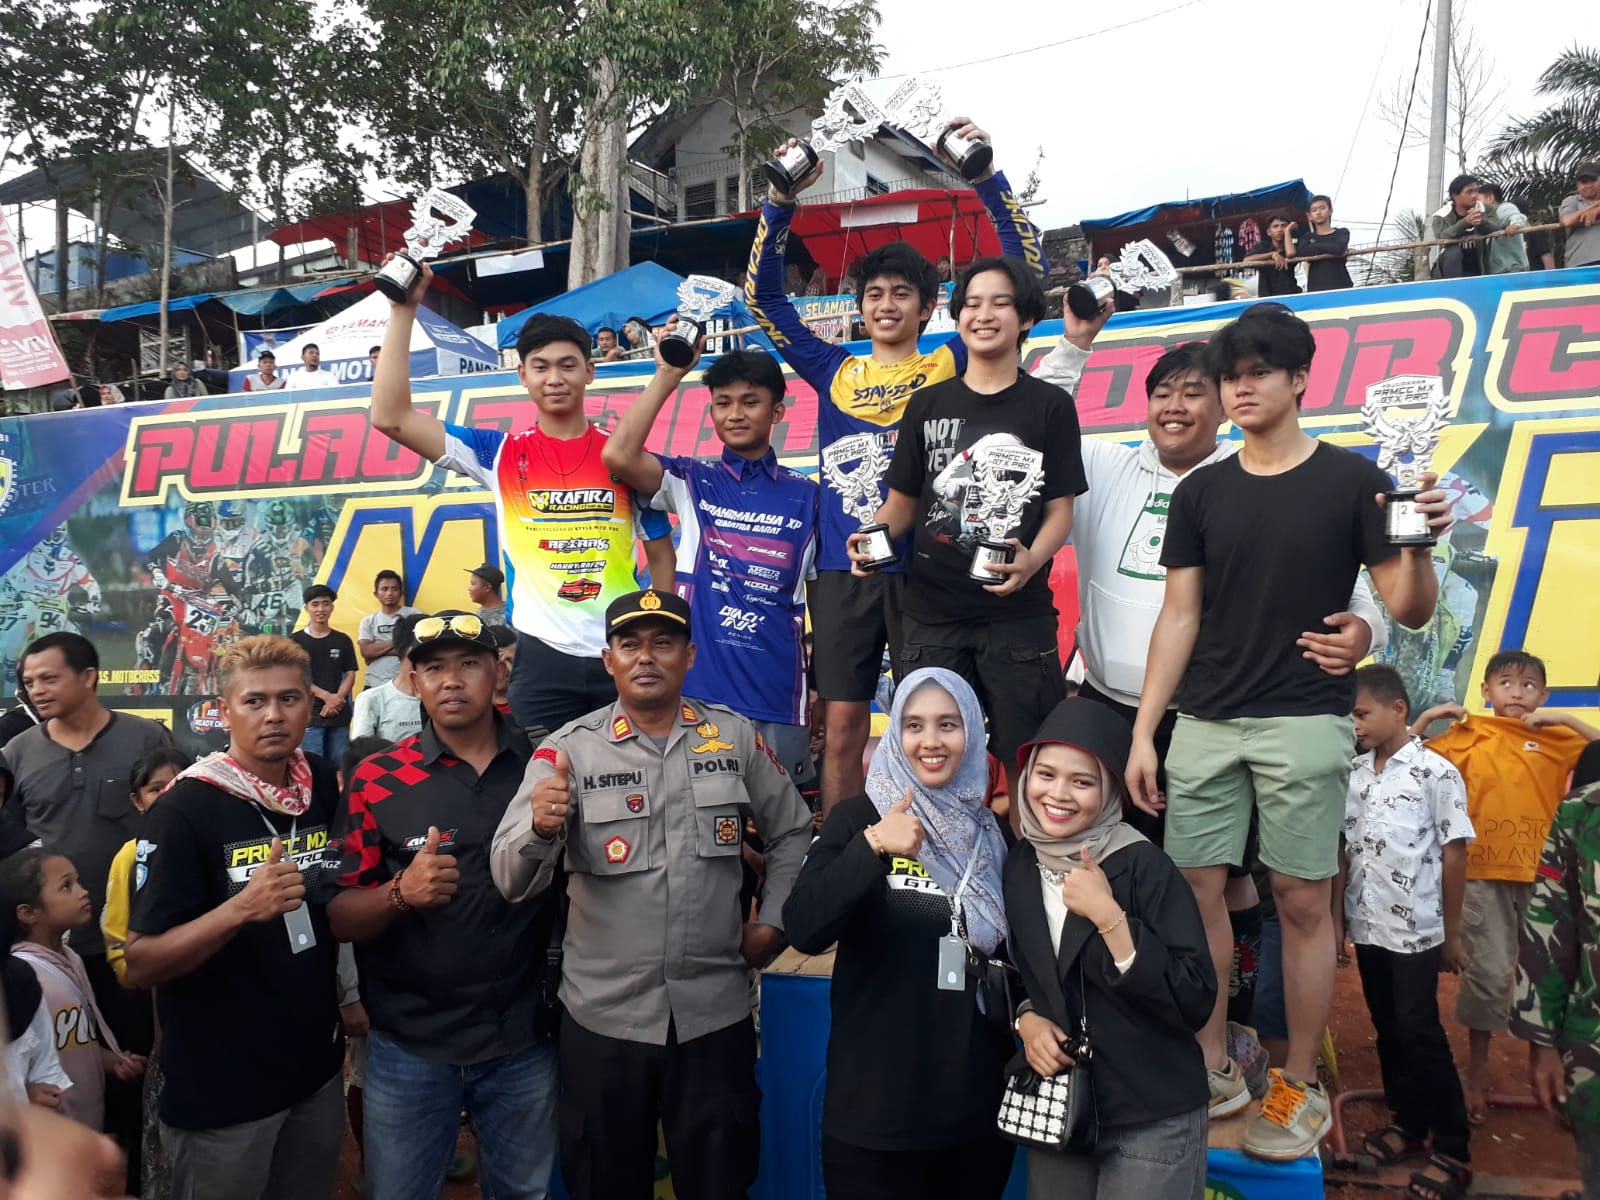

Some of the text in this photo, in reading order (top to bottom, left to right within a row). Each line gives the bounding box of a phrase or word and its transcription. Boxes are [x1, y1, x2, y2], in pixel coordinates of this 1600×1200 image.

[134, 408, 434, 493] PULAU
[549, 490, 614, 505] RAFIRA
[693, 758, 739, 775] POLRI
[583, 771, 642, 790] H. SITEPU
[306, 830, 328, 851] MX
[1471, 845, 1543, 865] RMAN
